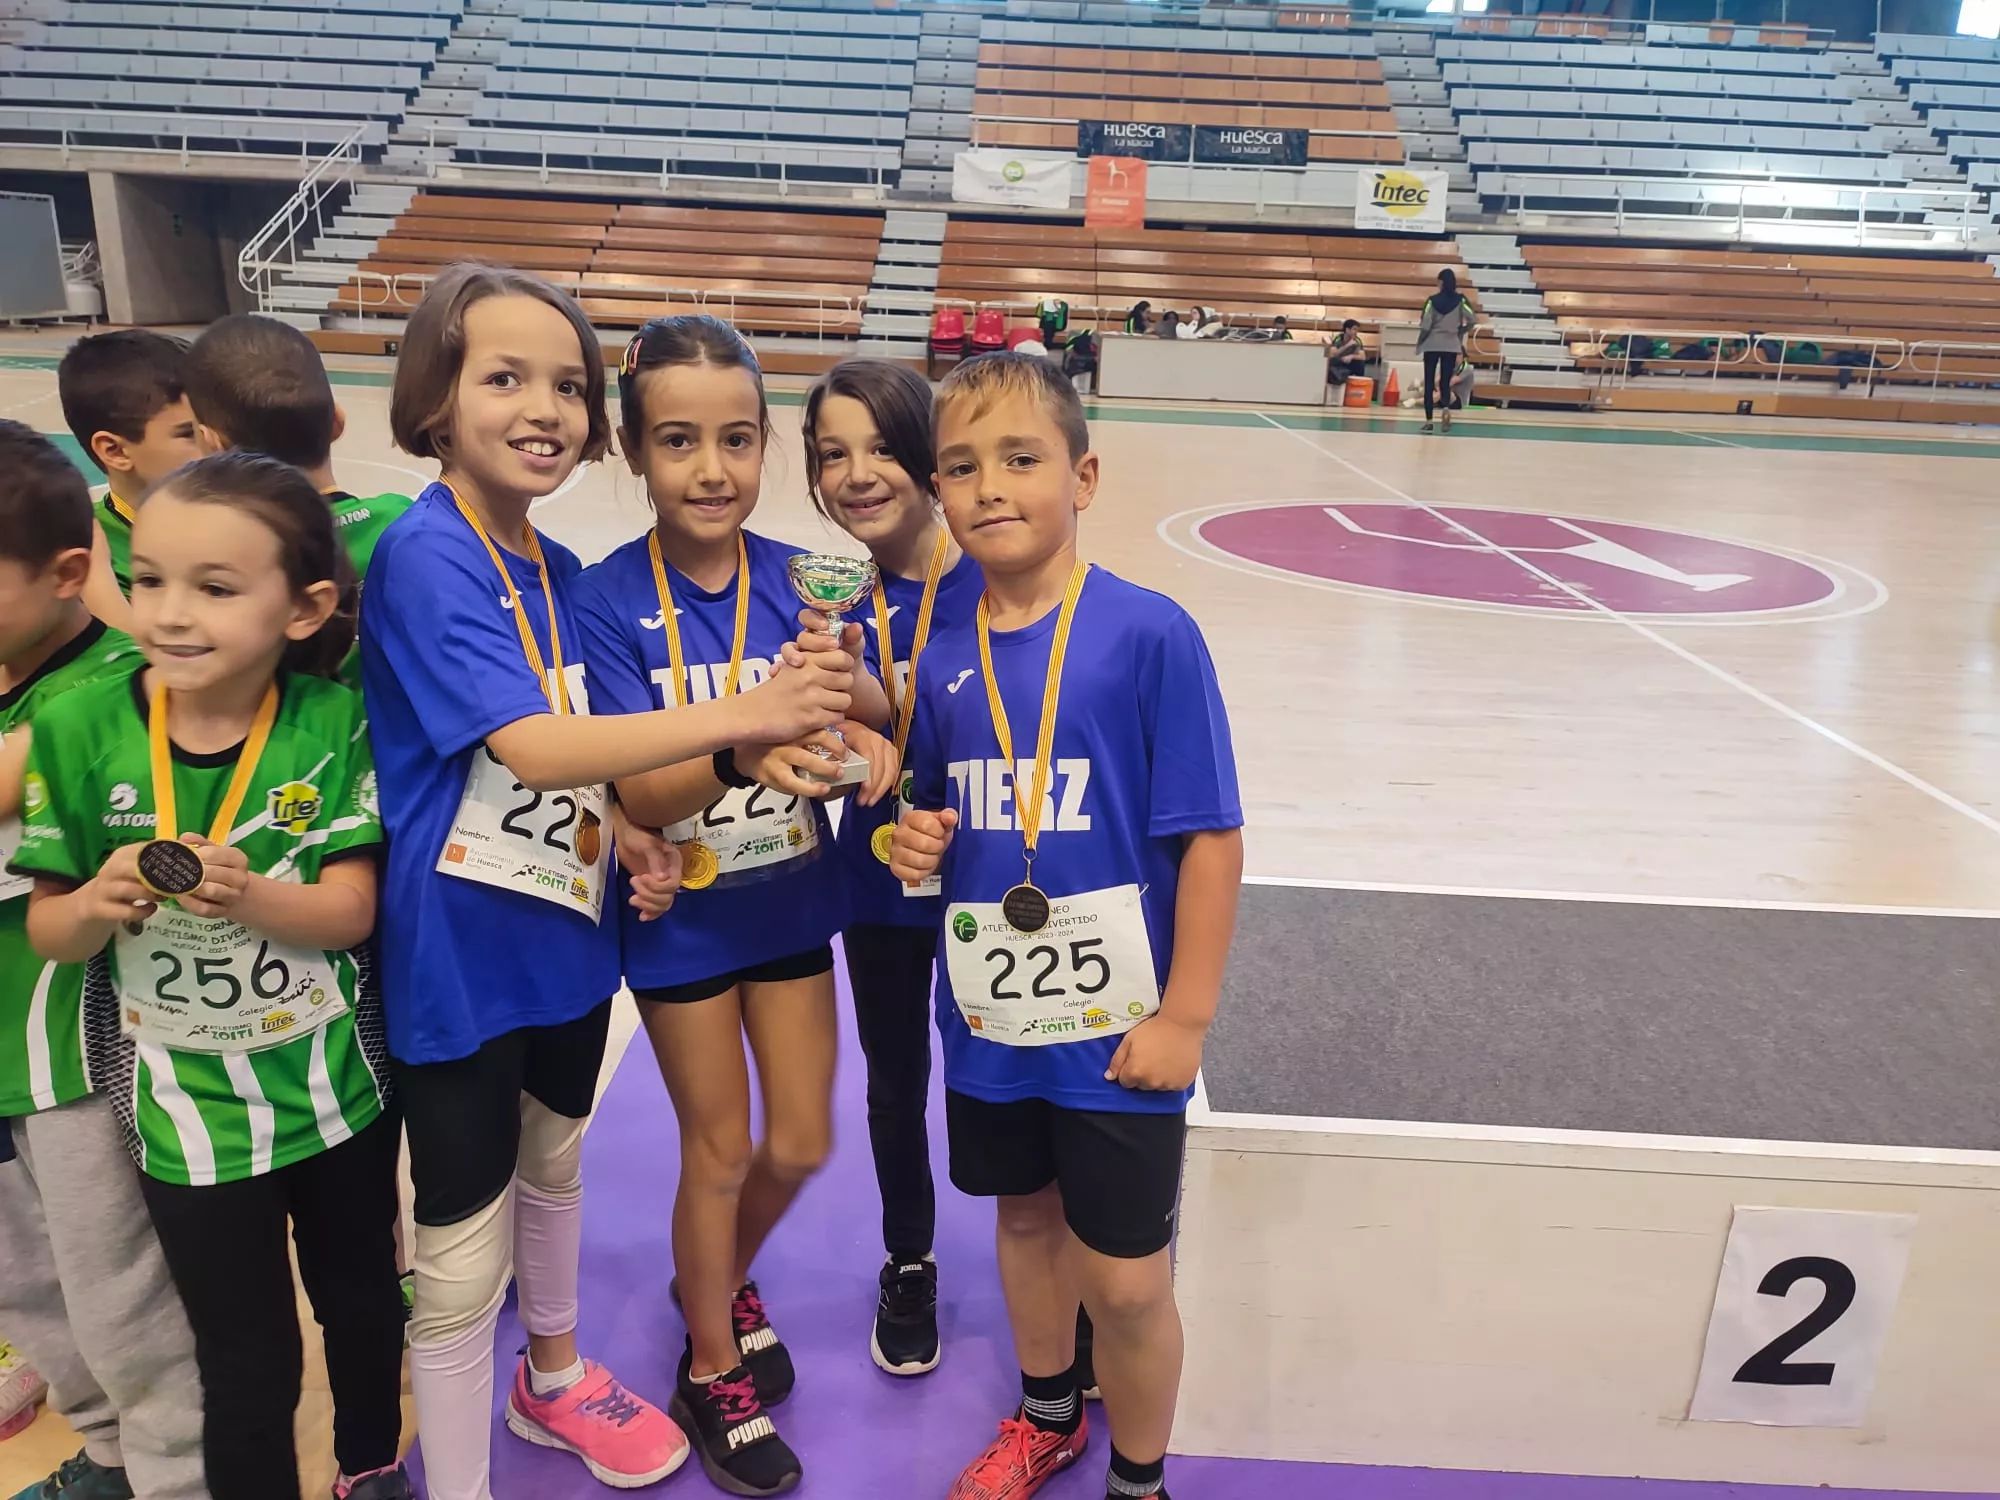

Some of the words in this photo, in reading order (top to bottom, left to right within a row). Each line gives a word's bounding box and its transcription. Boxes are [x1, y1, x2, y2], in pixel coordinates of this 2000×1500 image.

[754, 838, 785, 856] ZOITI
[535, 872, 567, 892] ZOITI
[150, 939, 290, 1010] 256
[984, 937, 1111, 1000] 225
[211, 1027, 254, 1041] ZOITI
[1040, 1021, 1077, 1035] ZOITI
[1731, 1255, 1857, 1386] 2
